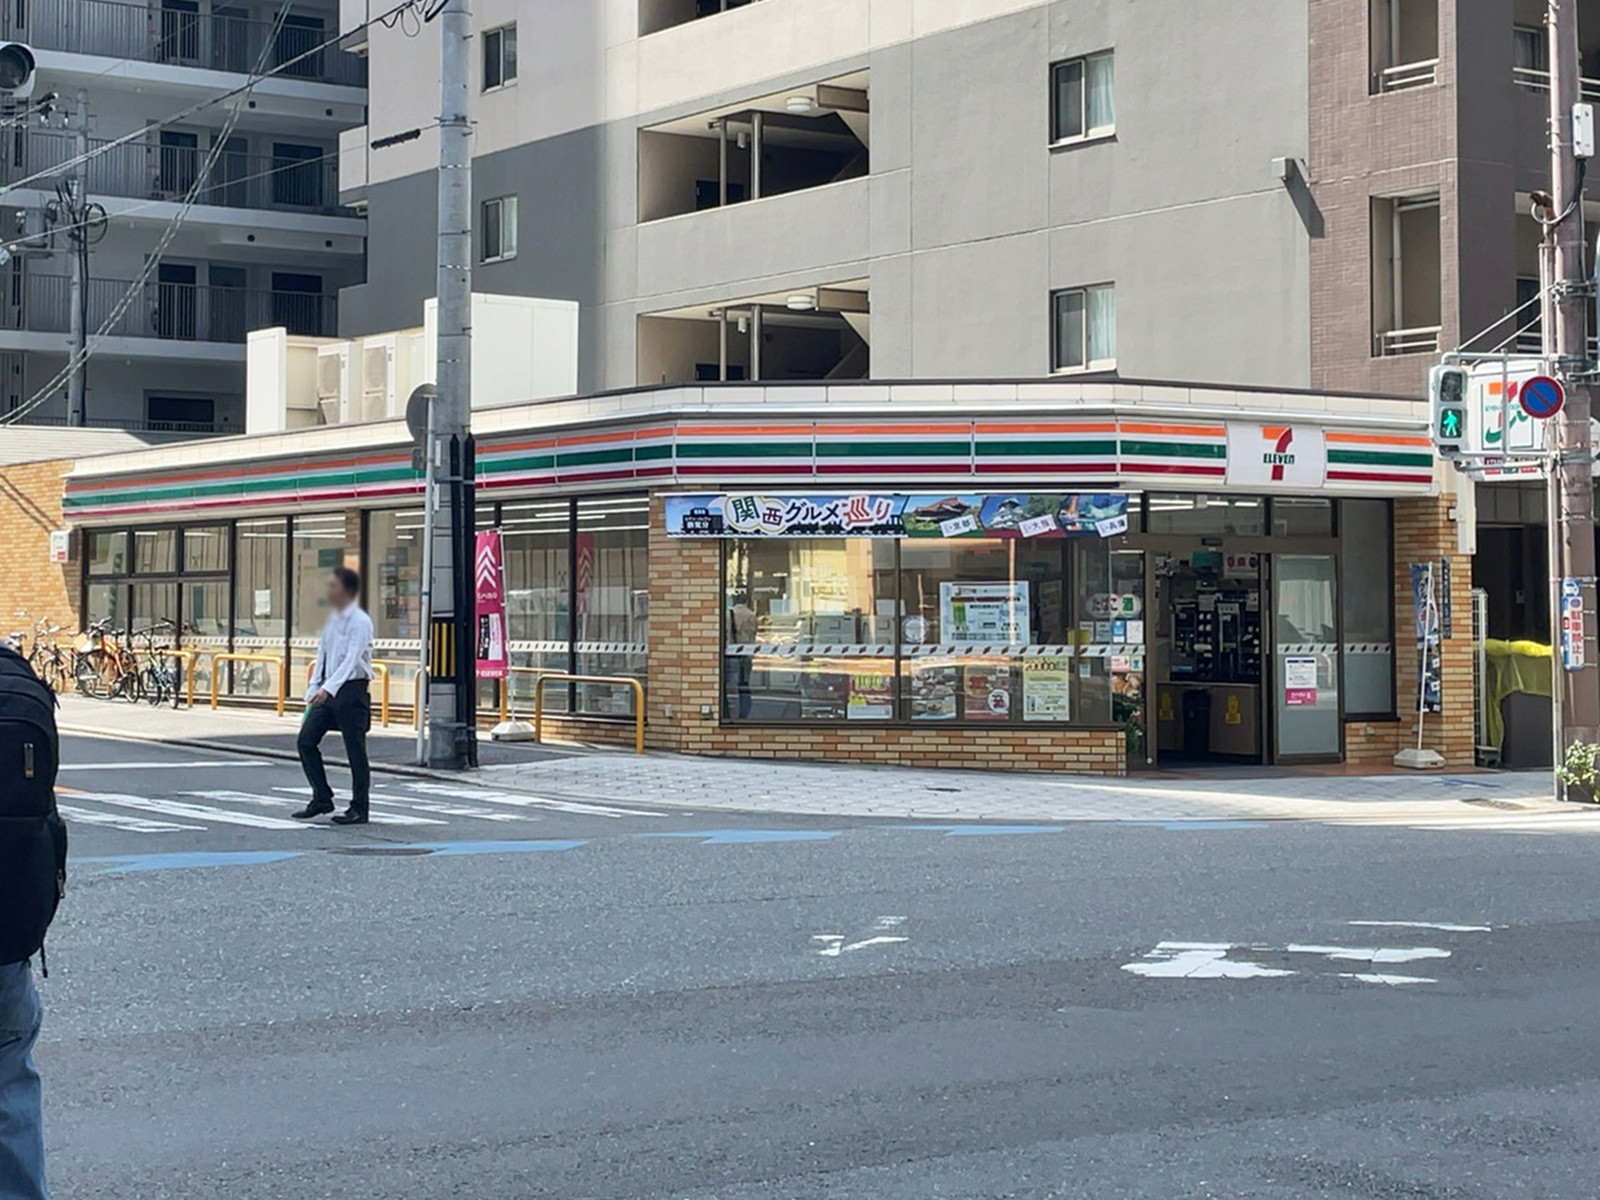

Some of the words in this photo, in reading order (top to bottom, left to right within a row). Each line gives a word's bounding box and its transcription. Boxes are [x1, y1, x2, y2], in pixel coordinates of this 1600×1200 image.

[732, 496, 891, 526] 関西グルメ巡り
